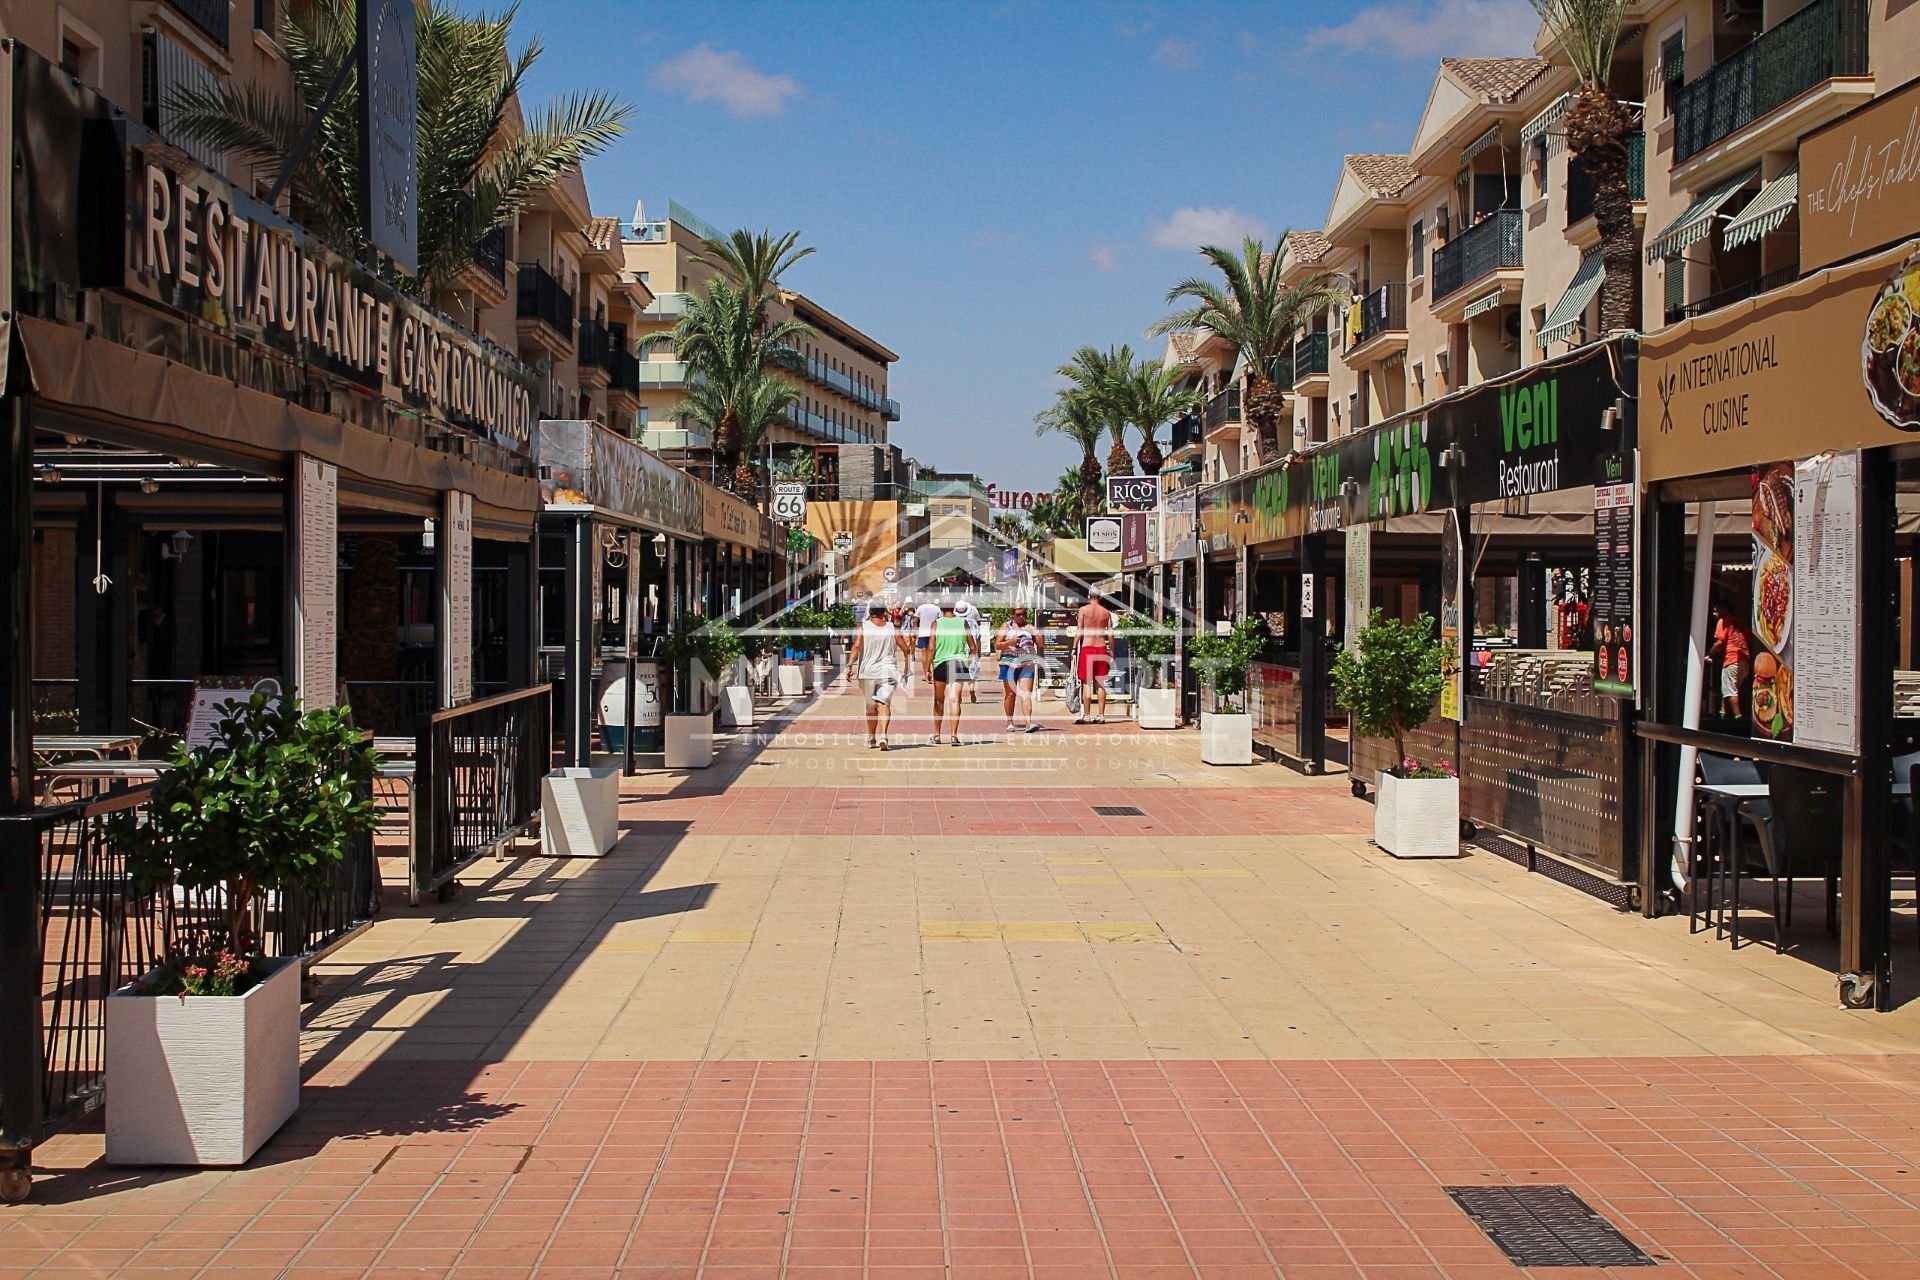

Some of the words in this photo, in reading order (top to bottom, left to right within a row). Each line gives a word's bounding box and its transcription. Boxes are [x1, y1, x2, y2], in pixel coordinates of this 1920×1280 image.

[1807, 189, 1825, 215] THE
[147, 165, 390, 375] RESTAURANTE
[1680, 335, 1778, 392] INTERNATIONAL
[1703, 394, 1748, 434] CUISINE
[1499, 448, 1558, 497] Restaurant
[1605, 456, 1622, 478] Veni
[777, 496, 802, 514] 66
